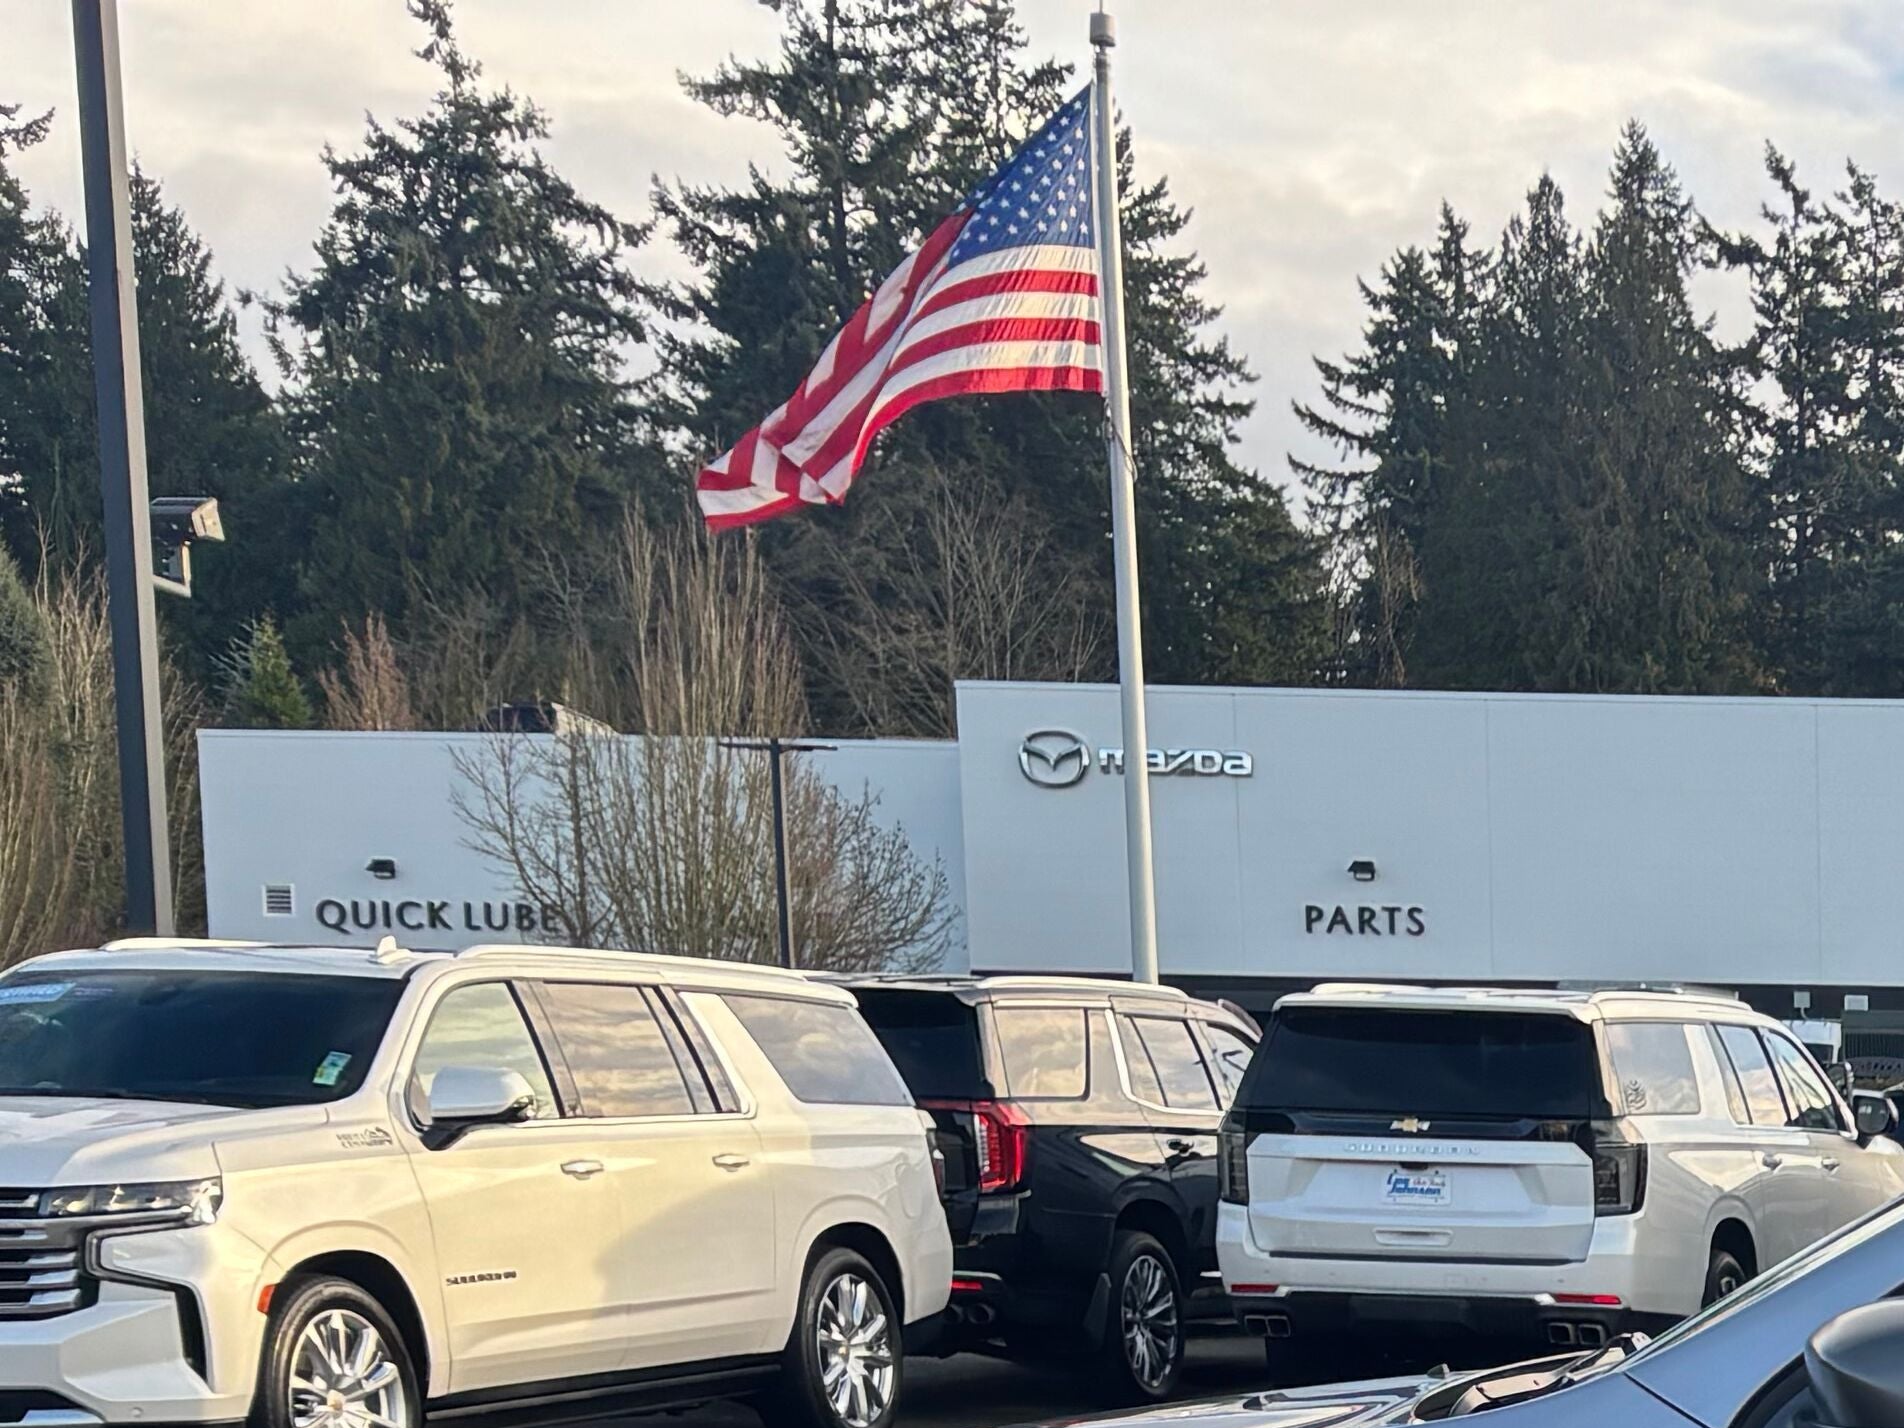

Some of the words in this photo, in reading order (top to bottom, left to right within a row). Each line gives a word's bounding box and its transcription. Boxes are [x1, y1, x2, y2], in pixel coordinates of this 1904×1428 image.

[315, 899, 452, 934] QUICK
[463, 901, 562, 931] LUBE
[1304, 905, 1425, 936] PARTS
